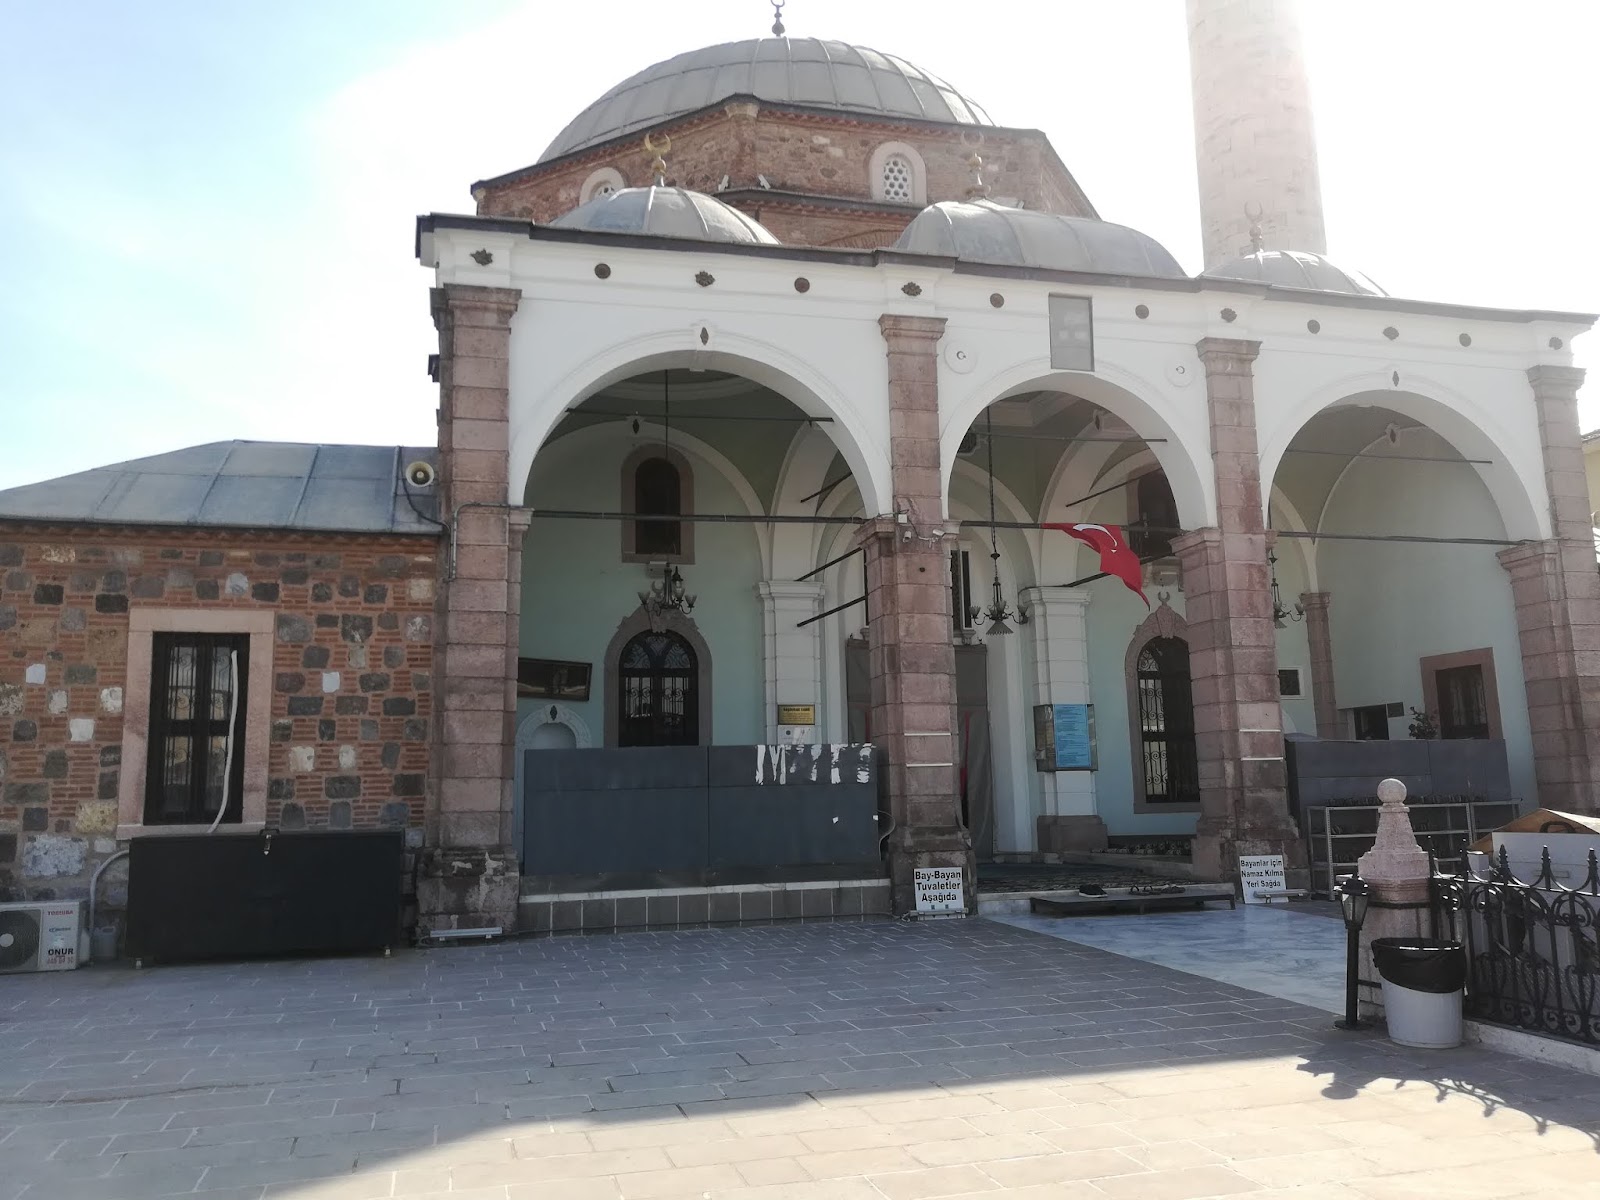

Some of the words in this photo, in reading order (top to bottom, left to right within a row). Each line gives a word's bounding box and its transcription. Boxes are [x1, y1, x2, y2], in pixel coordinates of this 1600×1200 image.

[1241, 859, 1269, 868] Bayanlar
[915, 871, 961, 881] Bay-Bayan
[1265, 869, 1283, 877] Kılma
[916, 882, 960, 890] Tuvaletler
[1261, 880, 1280, 888] Sağda
[922, 892, 956, 903] Aşağıda
